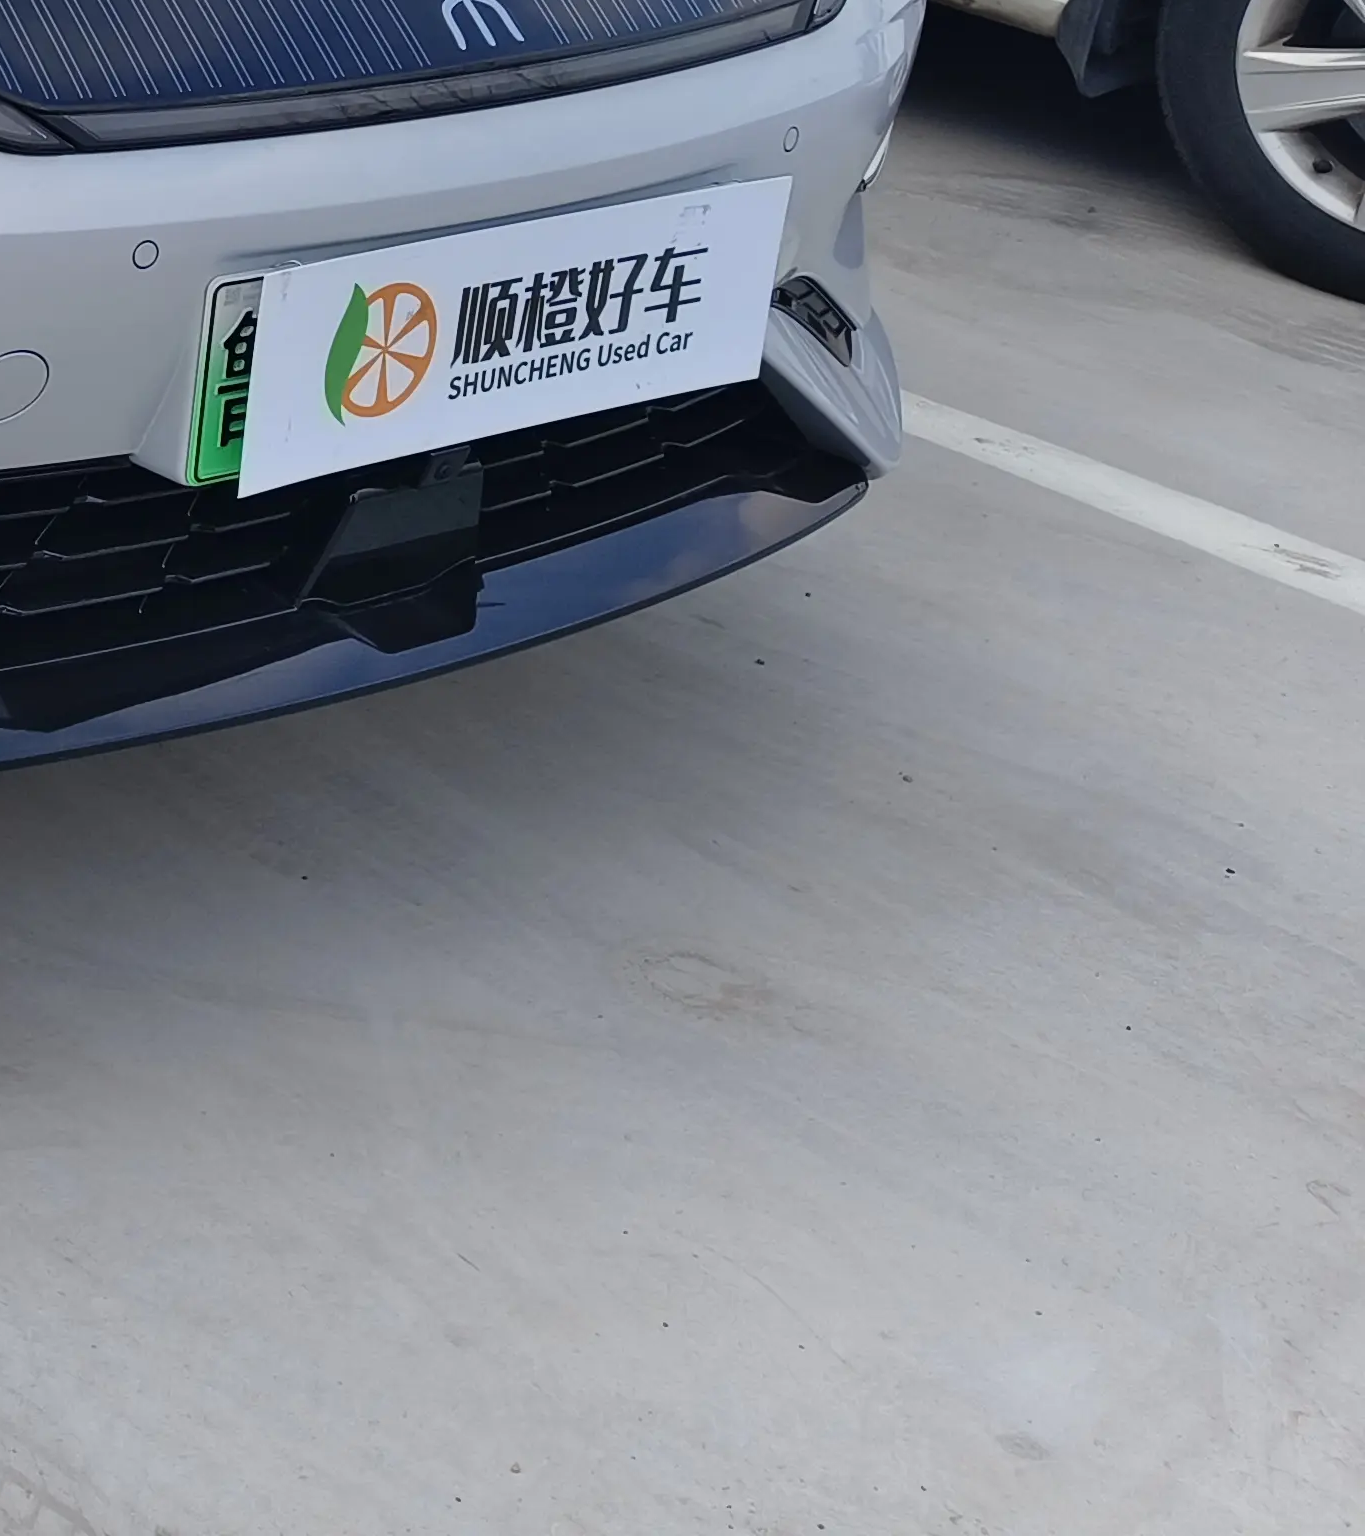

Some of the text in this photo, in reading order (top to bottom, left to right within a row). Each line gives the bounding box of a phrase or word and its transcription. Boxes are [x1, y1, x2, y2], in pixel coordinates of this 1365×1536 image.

[450, 246, 709, 368] 顺橙好车
[447, 330, 694, 401] SHUNCHENG Used Car
